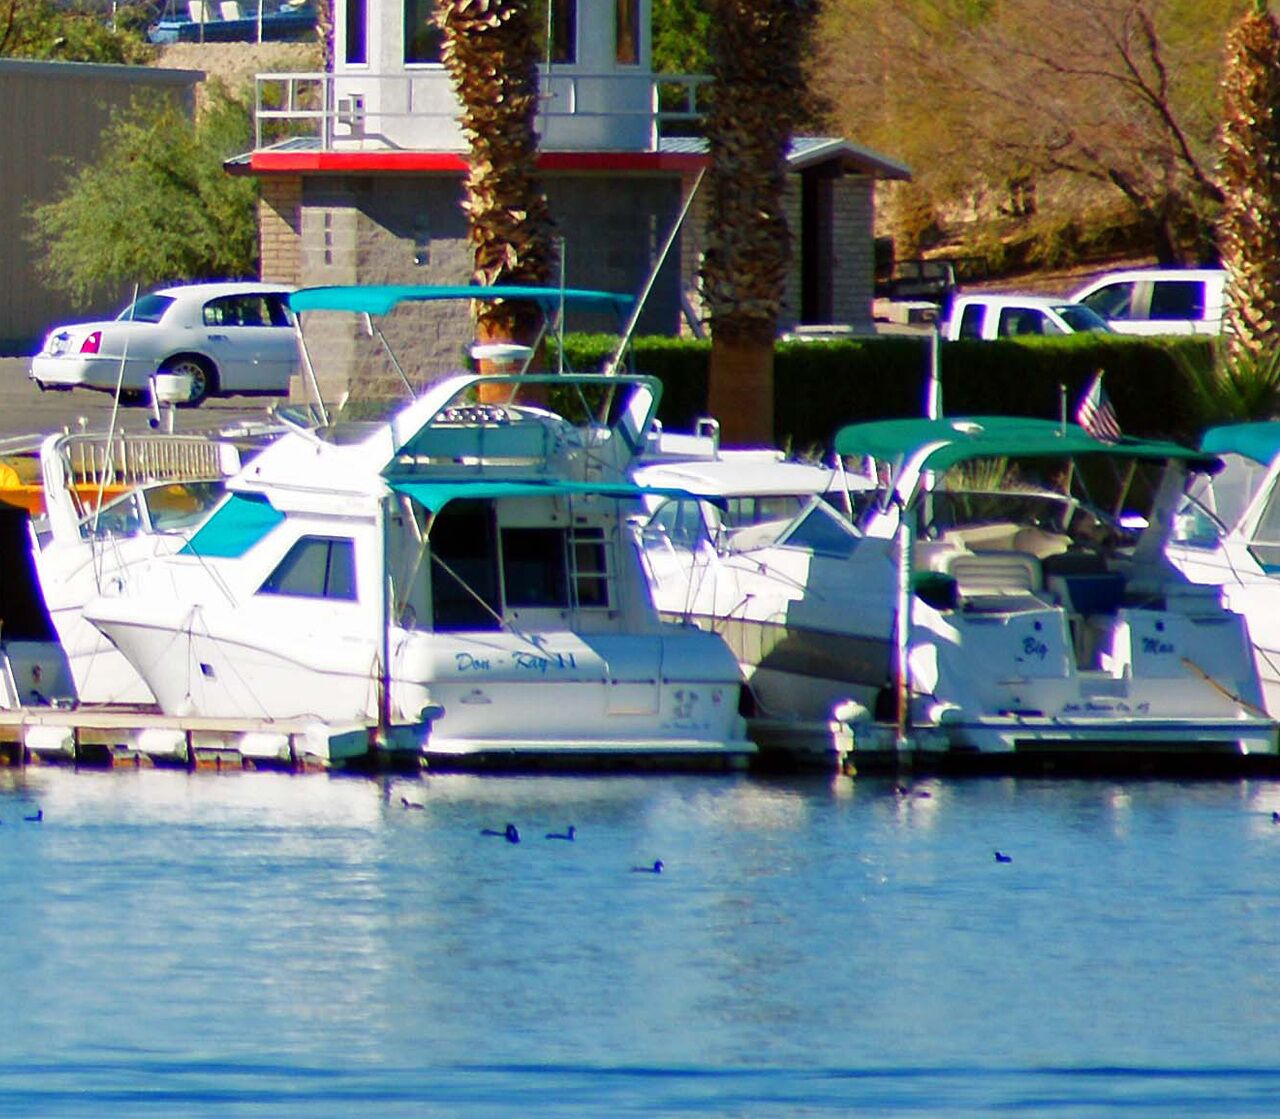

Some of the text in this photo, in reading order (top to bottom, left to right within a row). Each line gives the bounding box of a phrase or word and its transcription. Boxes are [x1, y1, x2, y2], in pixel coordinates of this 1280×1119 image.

[1023, 636, 1048, 661] Big
[455, 652, 490, 671] Don
[512, 651, 548, 673] Ray
